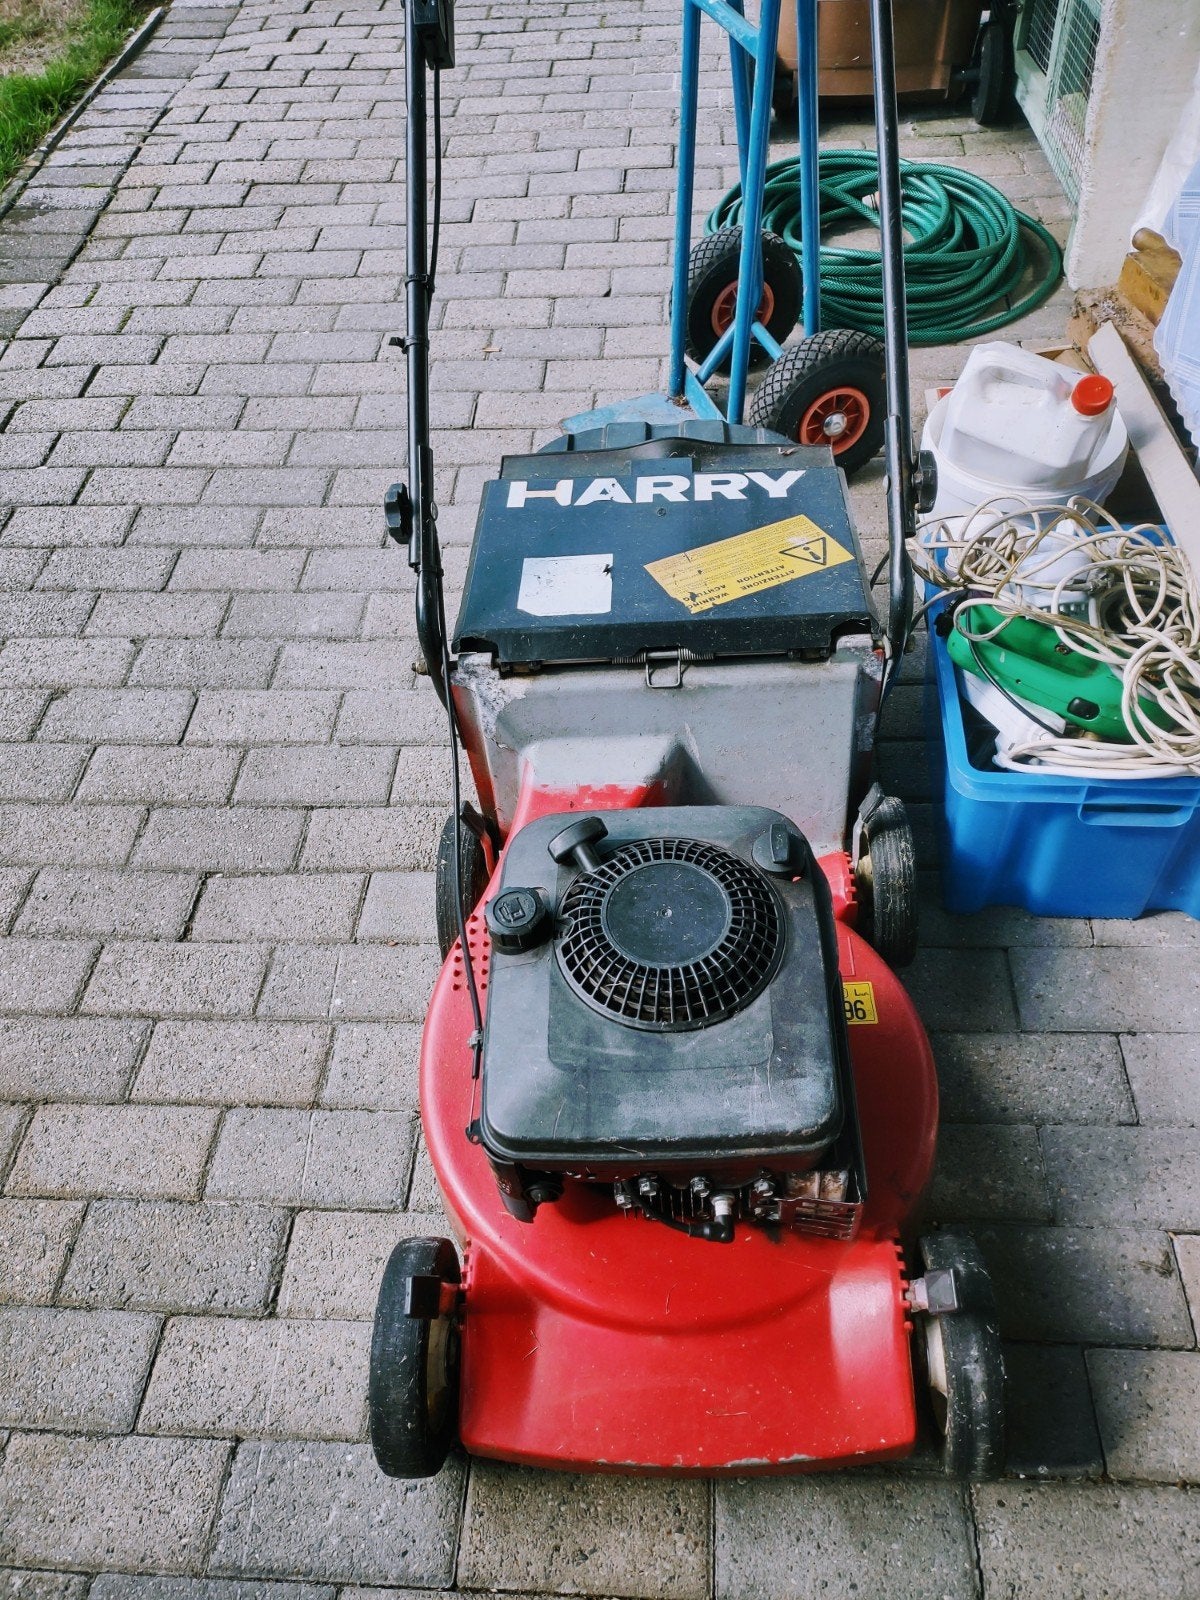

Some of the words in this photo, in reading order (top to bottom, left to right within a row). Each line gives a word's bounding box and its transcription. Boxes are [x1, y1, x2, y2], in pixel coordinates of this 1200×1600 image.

[506, 470, 806, 508] HARRY
[736, 564, 785, 583] ATTENTION
[741, 569, 795, 591] ATTENZIONE
[683, 584, 726, 602] ACHTUG
[843, 999, 867, 1020] 96
